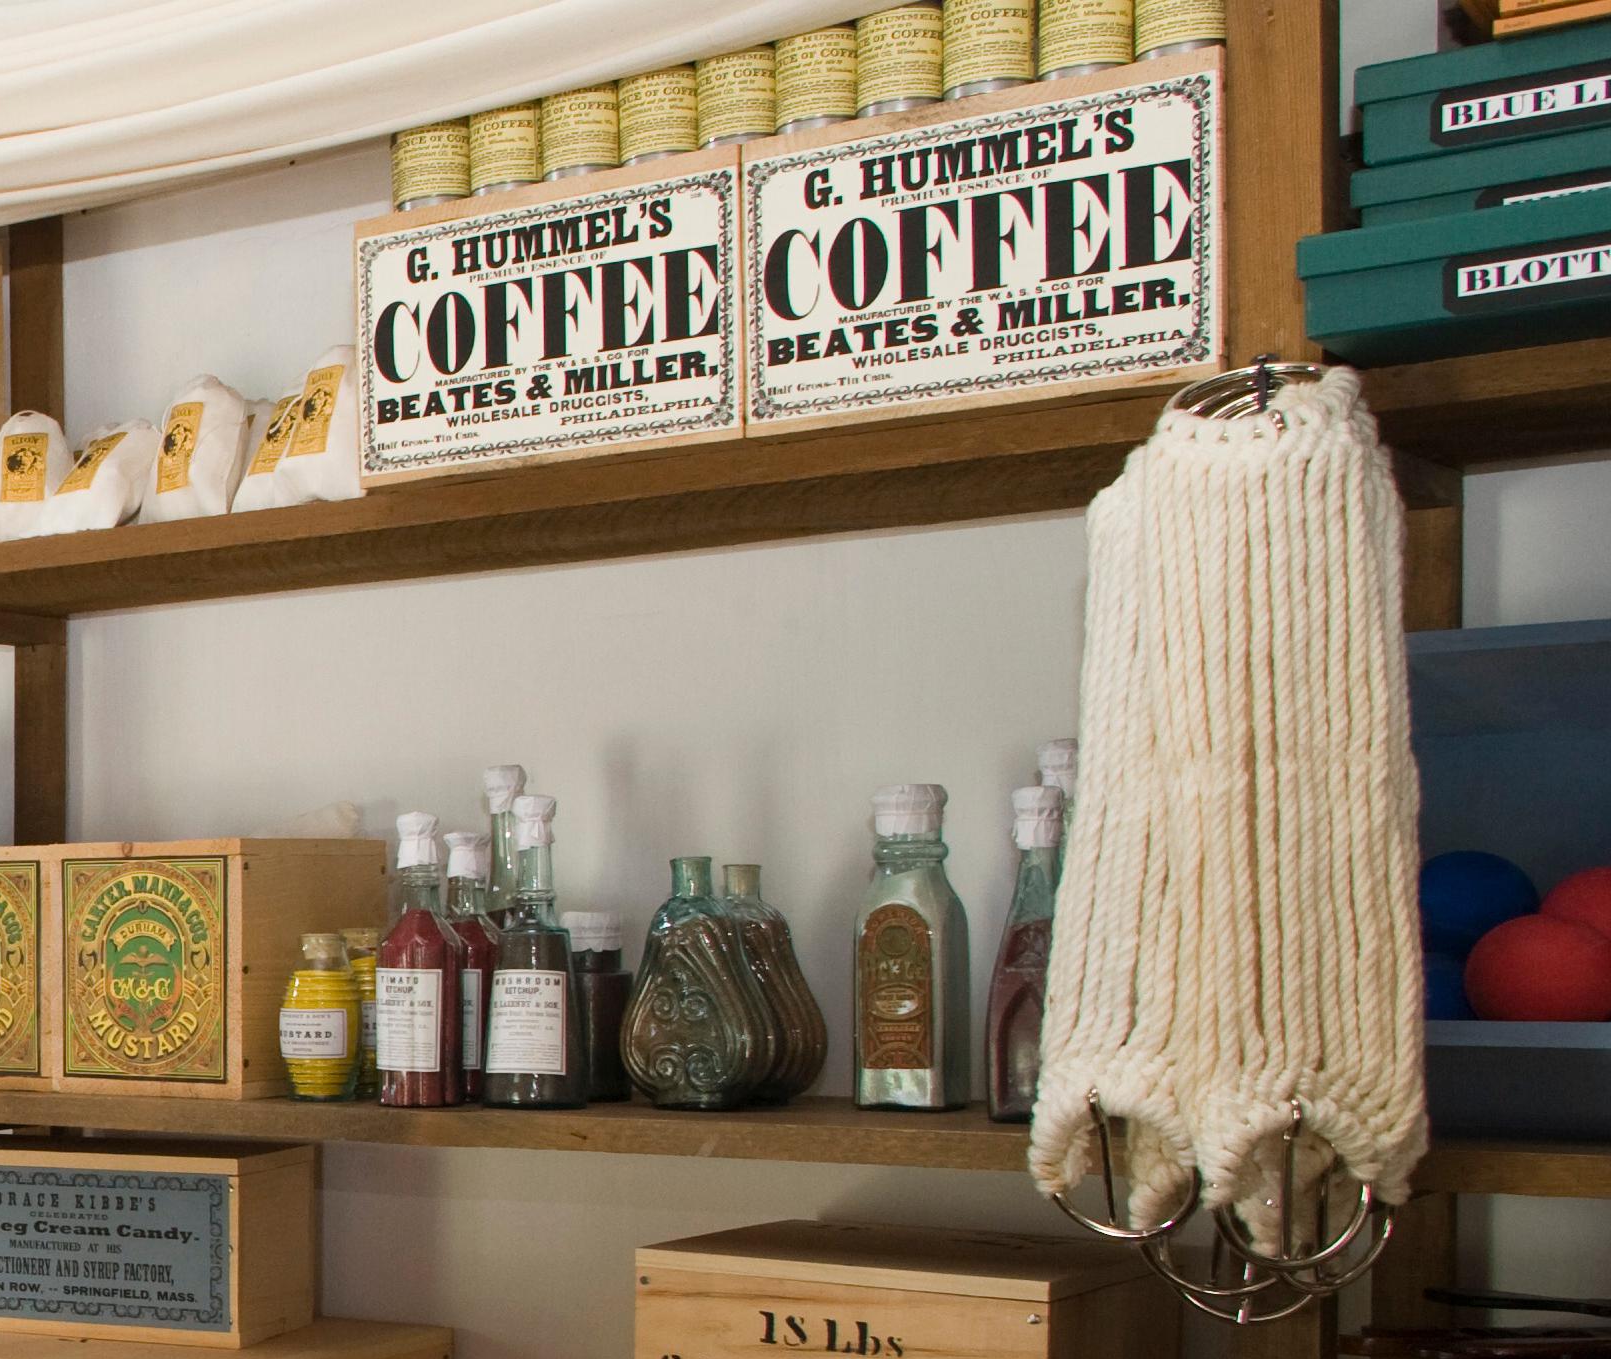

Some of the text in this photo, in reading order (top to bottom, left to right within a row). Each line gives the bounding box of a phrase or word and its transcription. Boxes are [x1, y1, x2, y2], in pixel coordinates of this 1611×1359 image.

[483, 119, 533, 131] COFFEE
[1448, 87, 1556, 127] BLUE
[804, 108, 1135, 210] G. HUMMEL'S
[880, 169, 1051, 208] PREMIUM ESSENCE OF
[406, 197, 674, 283] G. HUMMEL'S
[763, 158, 1192, 322] COFFEE
[468, 250, 608, 284] PREMIUM ESSENCE OF
[374, 244, 719, 384] COFFEE
[768, 279, 1191, 367] BEATES & MILLER,
[838, 295, 982, 324] MANUFACTURED BY THE
[851, 323, 1103, 369] WHOLESALE DRUGGISTS,
[992, 330, 1186, 366] PHILADELPHIA
[377, 351, 719, 425] BEATES & MILLER,
[446, 389, 649, 428] WHOLESALE DRUGGISTS,
[559, 396, 715, 427] PHILADELPHIA
[82, 878, 131, 943] CARTER
[132, 874, 181, 903] MANN
[119, 920, 167, 940] DURHAM
[87, 1007, 200, 1060] MUSTARD
[30, 1212, 109, 1221] CELEBRATED
[75, 1194, 157, 1212] KIBBE'S
[9, 1240, 122, 1254] MANUFACTURED AT HIS
[33, 1221, 111, 1237] Cream
[116, 1224, 200, 1244] Candy.
[9, 1282, 44, 1294] ROW,
[63, 1286, 152, 1302] SPRINGFIELD,
[157, 1291, 198, 1303] MASS.
[55, 1260, 79, 1278] AND
[84, 1262, 120, 1281] SYRUP
[124, 1265, 175, 1286] FACTORY,
[759, 1310, 905, 1359] 18 Lbs
